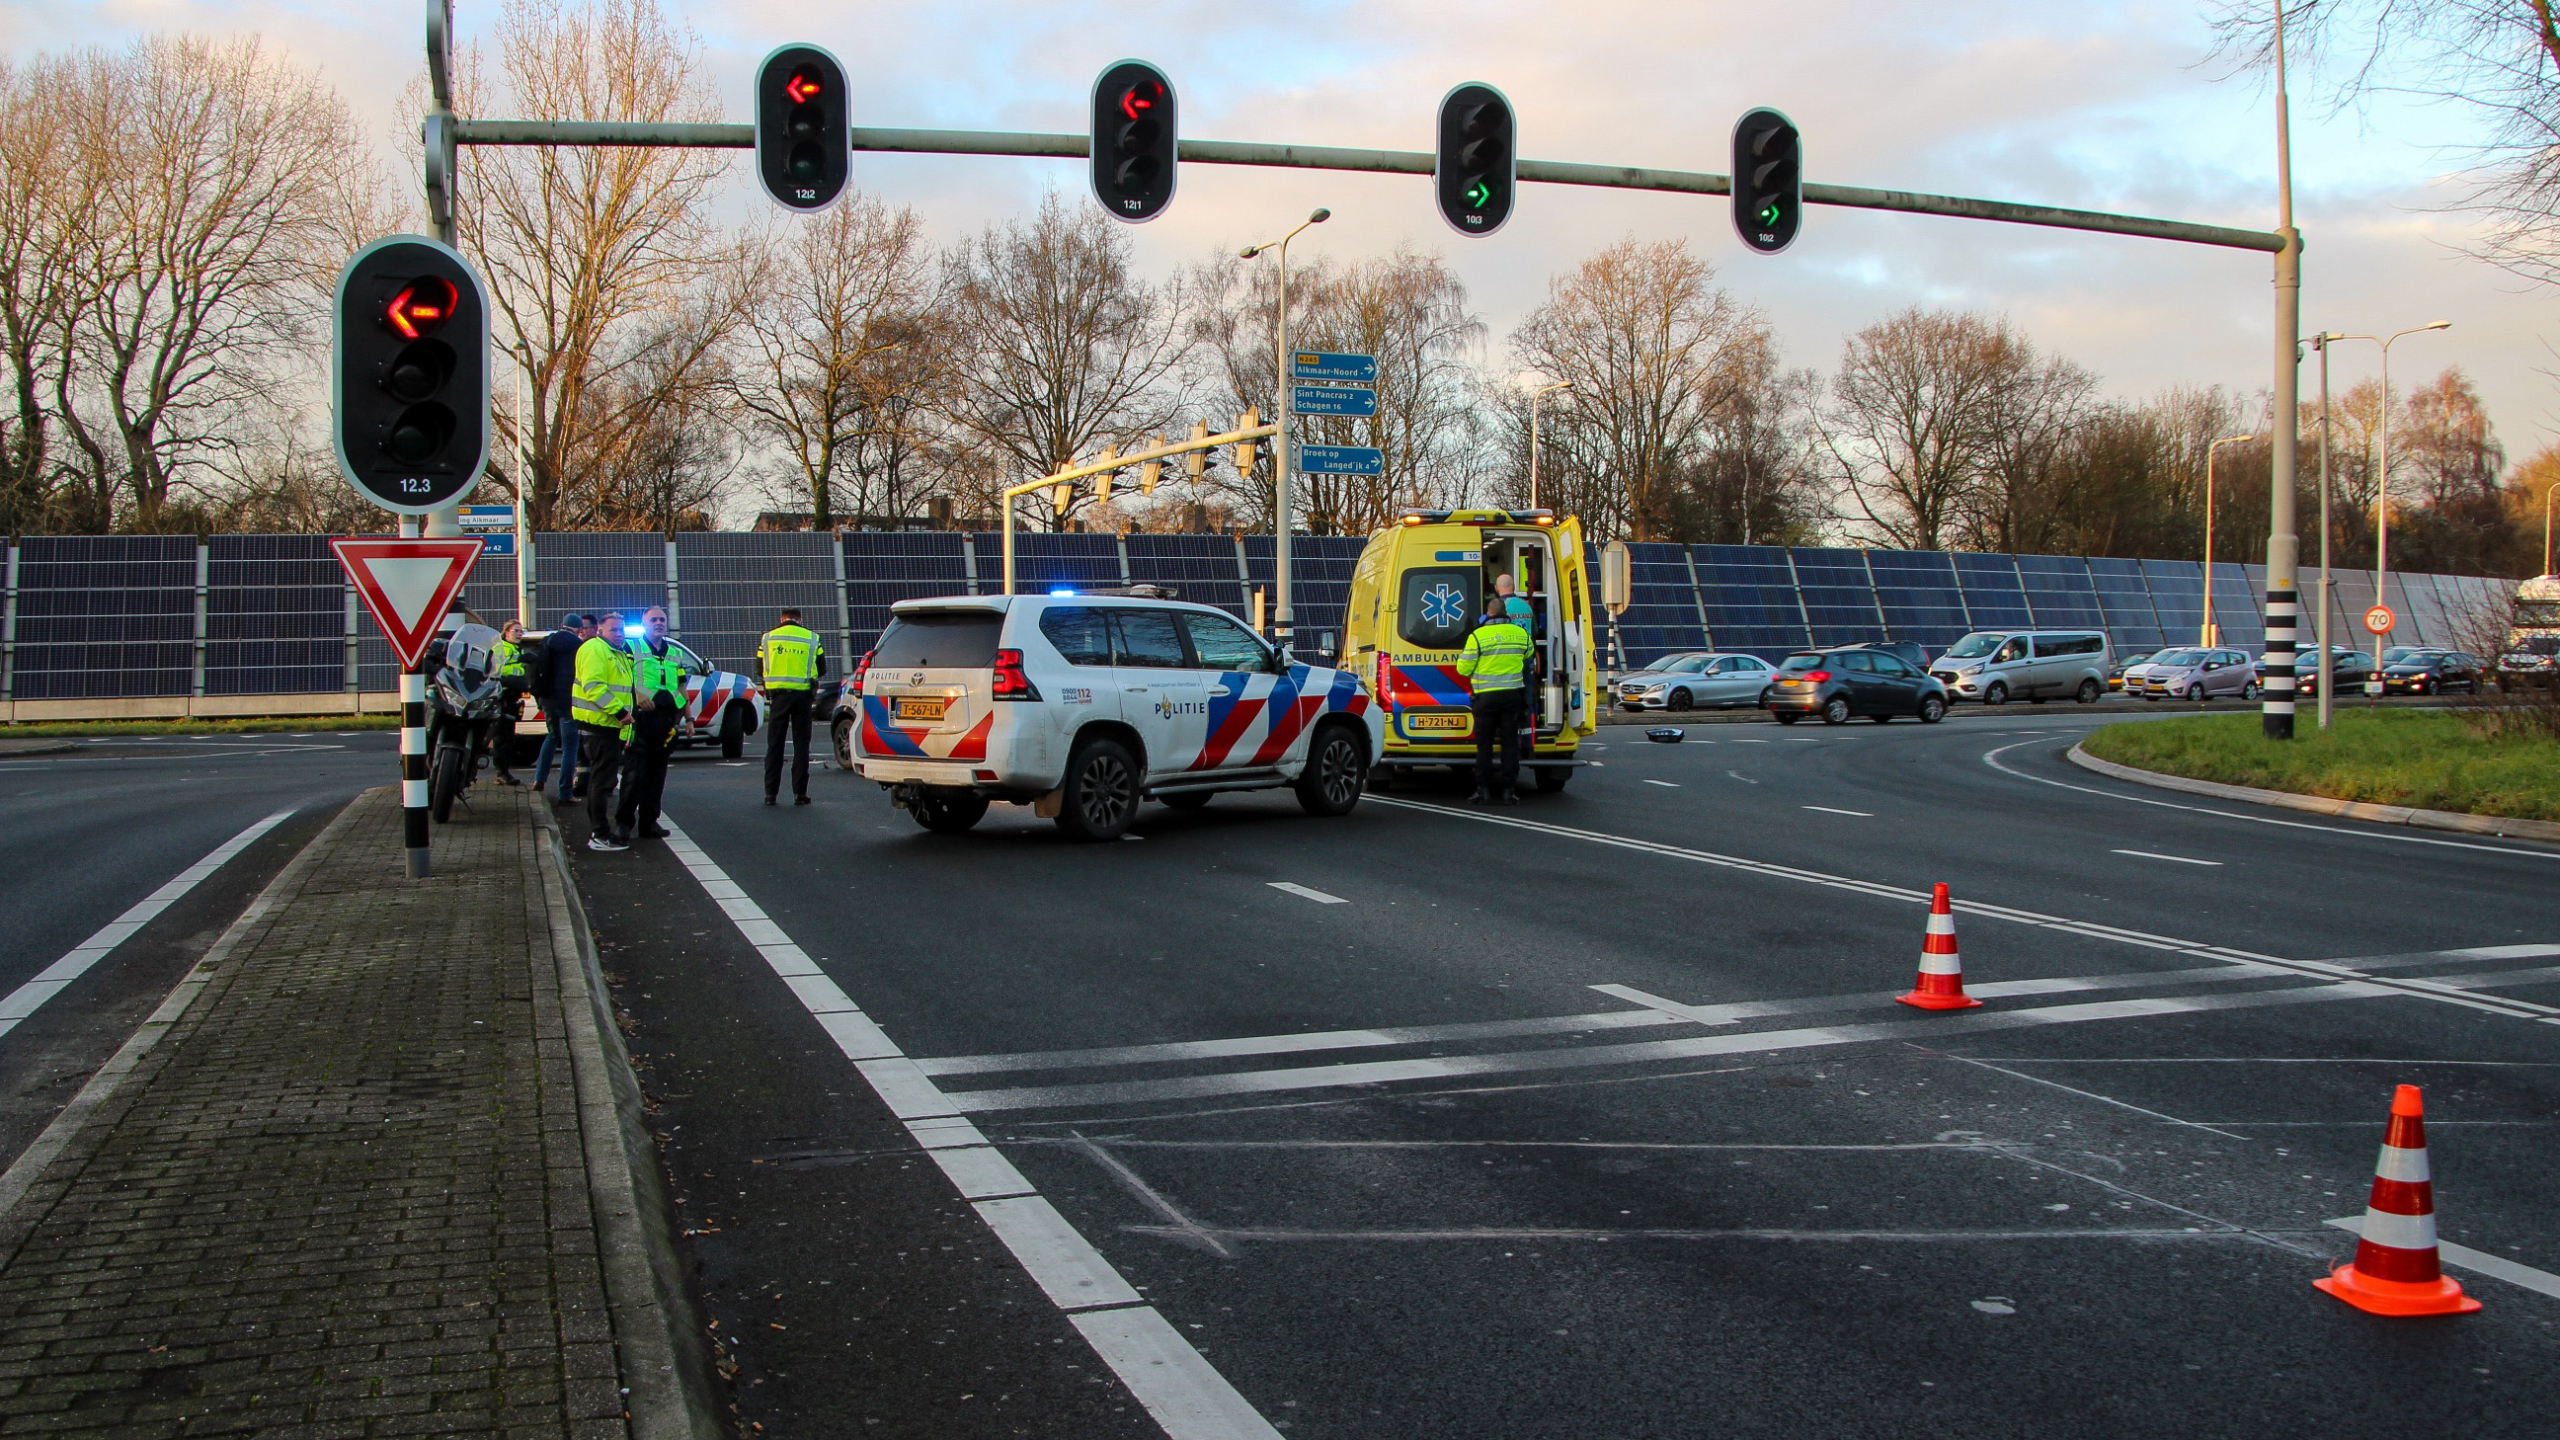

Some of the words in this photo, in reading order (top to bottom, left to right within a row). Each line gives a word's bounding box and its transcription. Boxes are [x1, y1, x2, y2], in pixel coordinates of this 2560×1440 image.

[1297, 366, 1358, 377] Alkmaar-Noord
[1297, 389, 1314, 398] Sint
[1316, 390, 1347, 400] Pancras
[1297, 401, 1331, 411] Schagen
[1303, 448, 1327, 457] Broek
[1328, 450, 1340, 459] op
[400, 478, 431, 493] 12.3
[493, 544, 502, 552] 42
[2369, 614, 2389, 625] 70
[1393, 653, 1460, 662] AMBULAN
[871, 672, 901, 680] POLITIE
[1077, 688, 1092, 698] 112
[903, 704, 942, 716] T-567-LN
[1155, 702, 1205, 720] POLITIE
[1418, 717, 1460, 727] H-721-NJ
